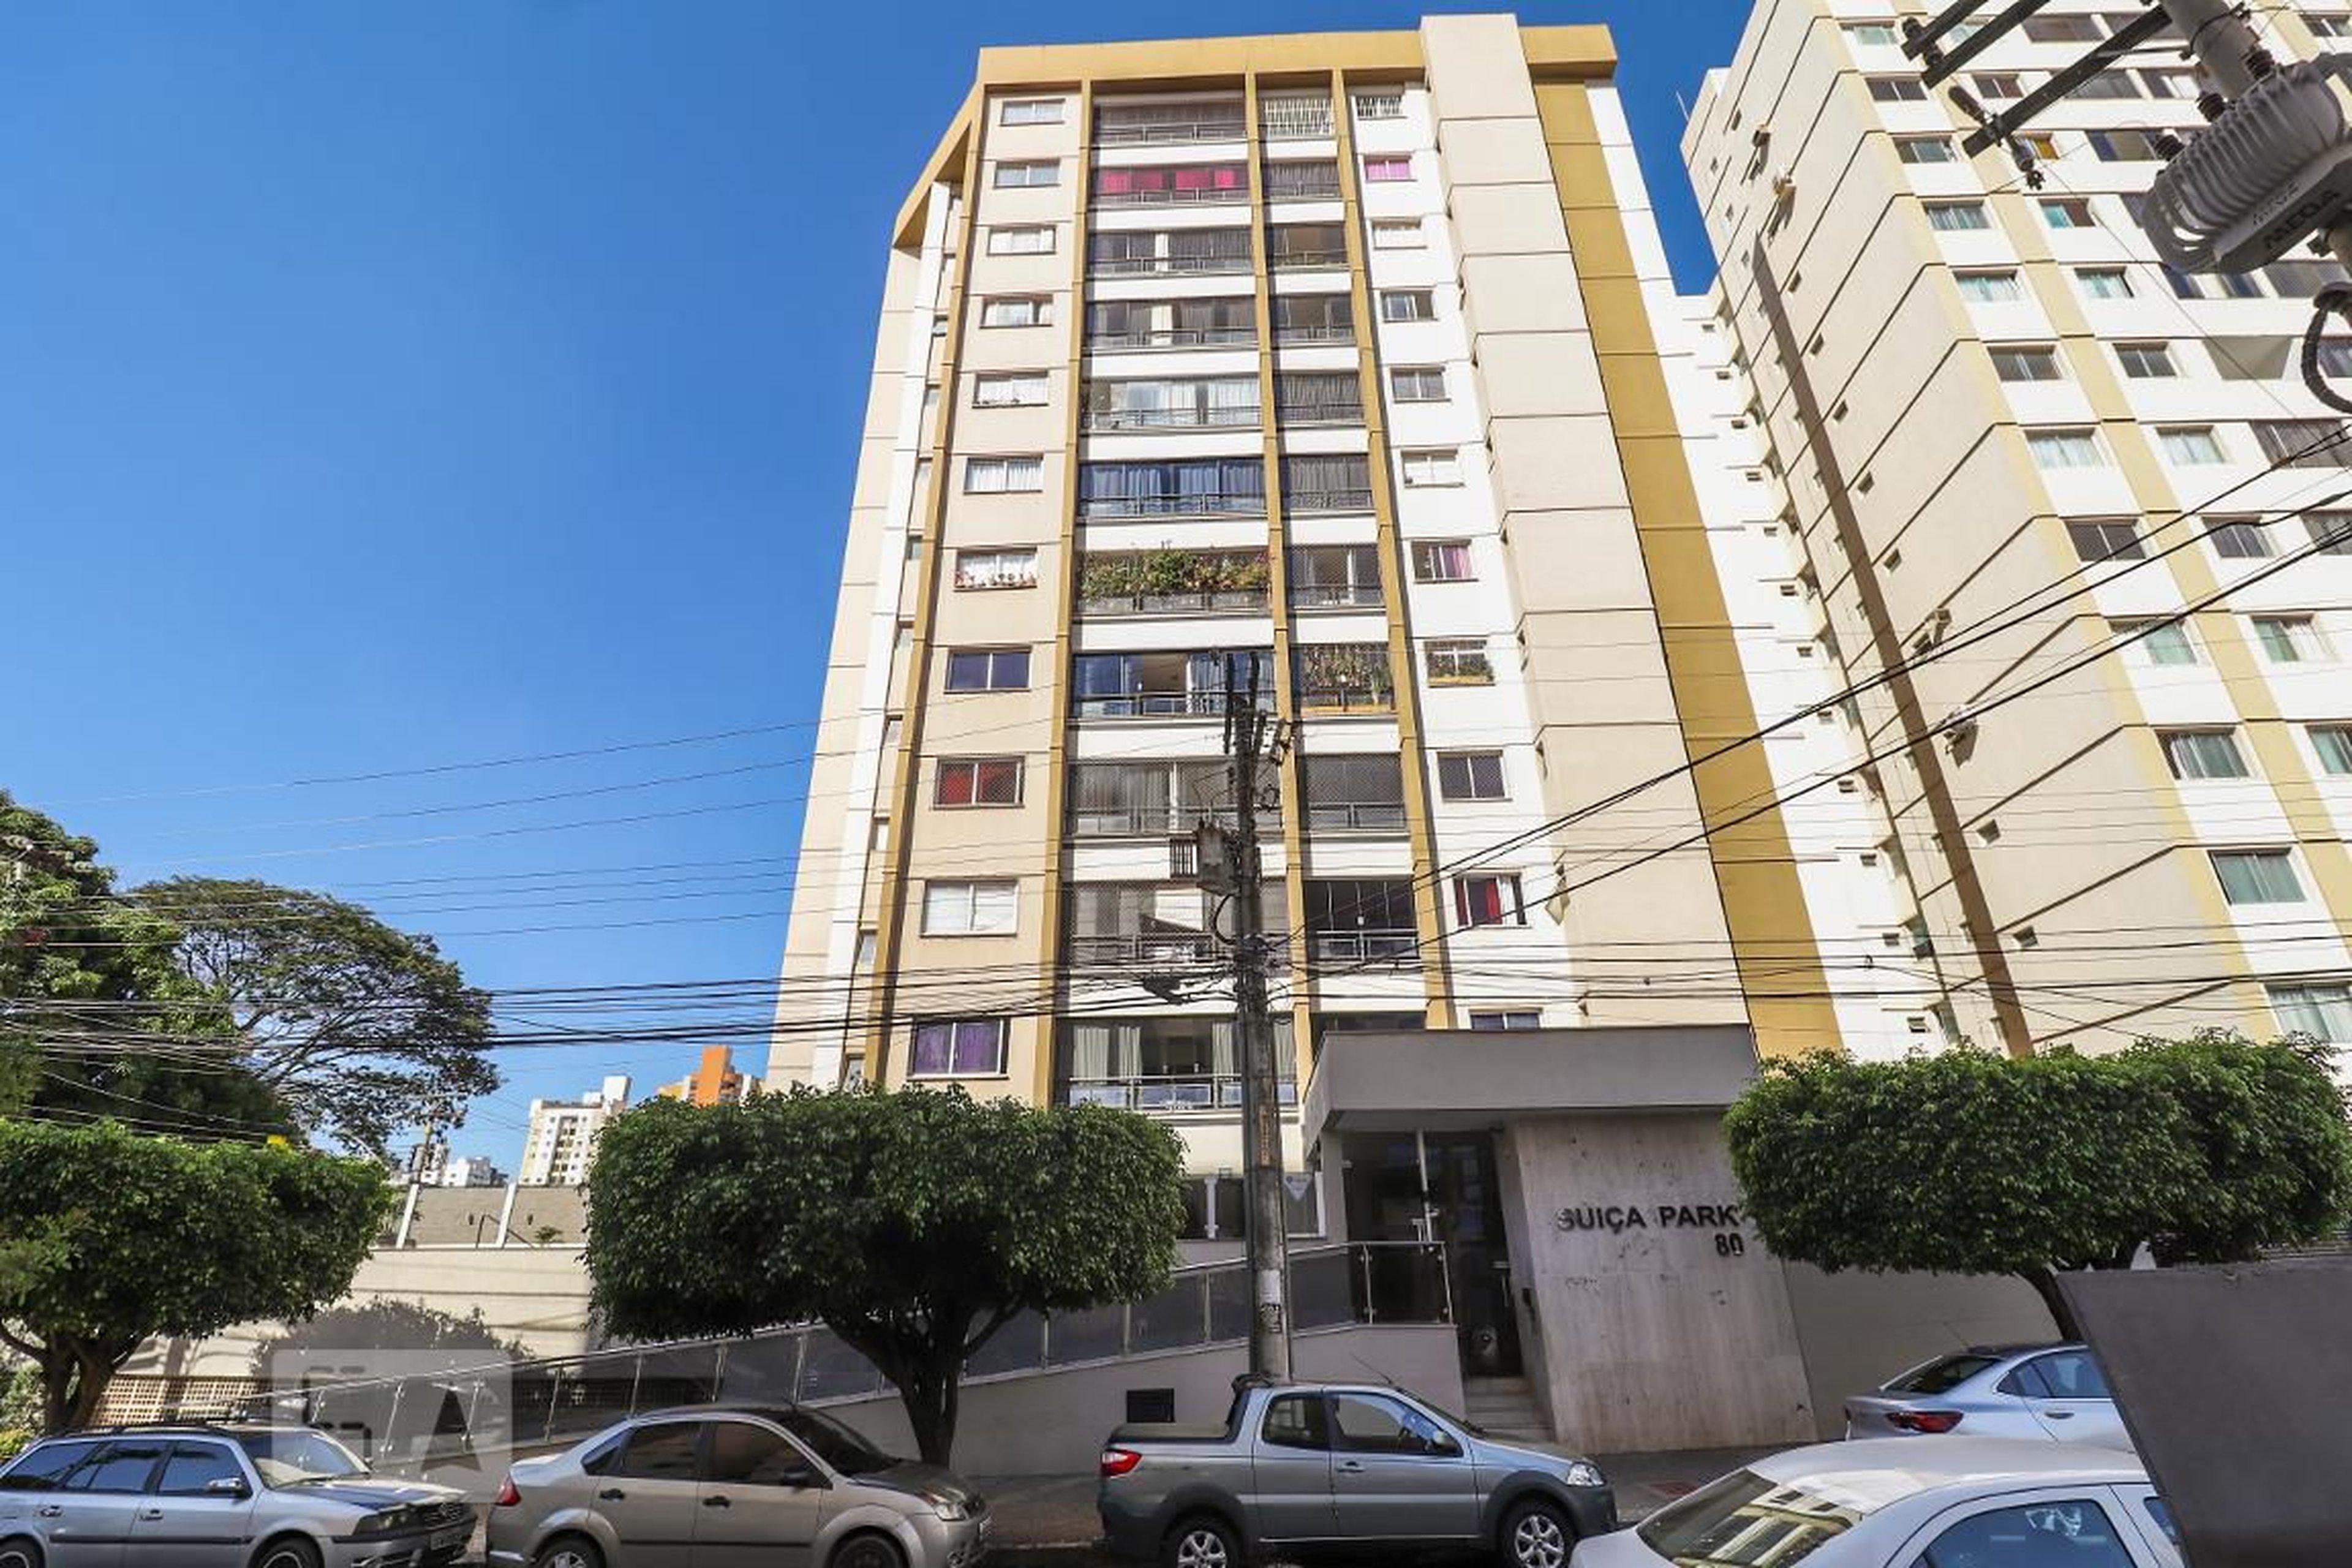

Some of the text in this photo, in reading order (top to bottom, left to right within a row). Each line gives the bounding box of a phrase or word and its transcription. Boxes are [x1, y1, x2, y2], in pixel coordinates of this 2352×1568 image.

[1557, 1205, 1740, 1235] SUIÇA PARK
[1715, 1232, 1744, 1257] 80
